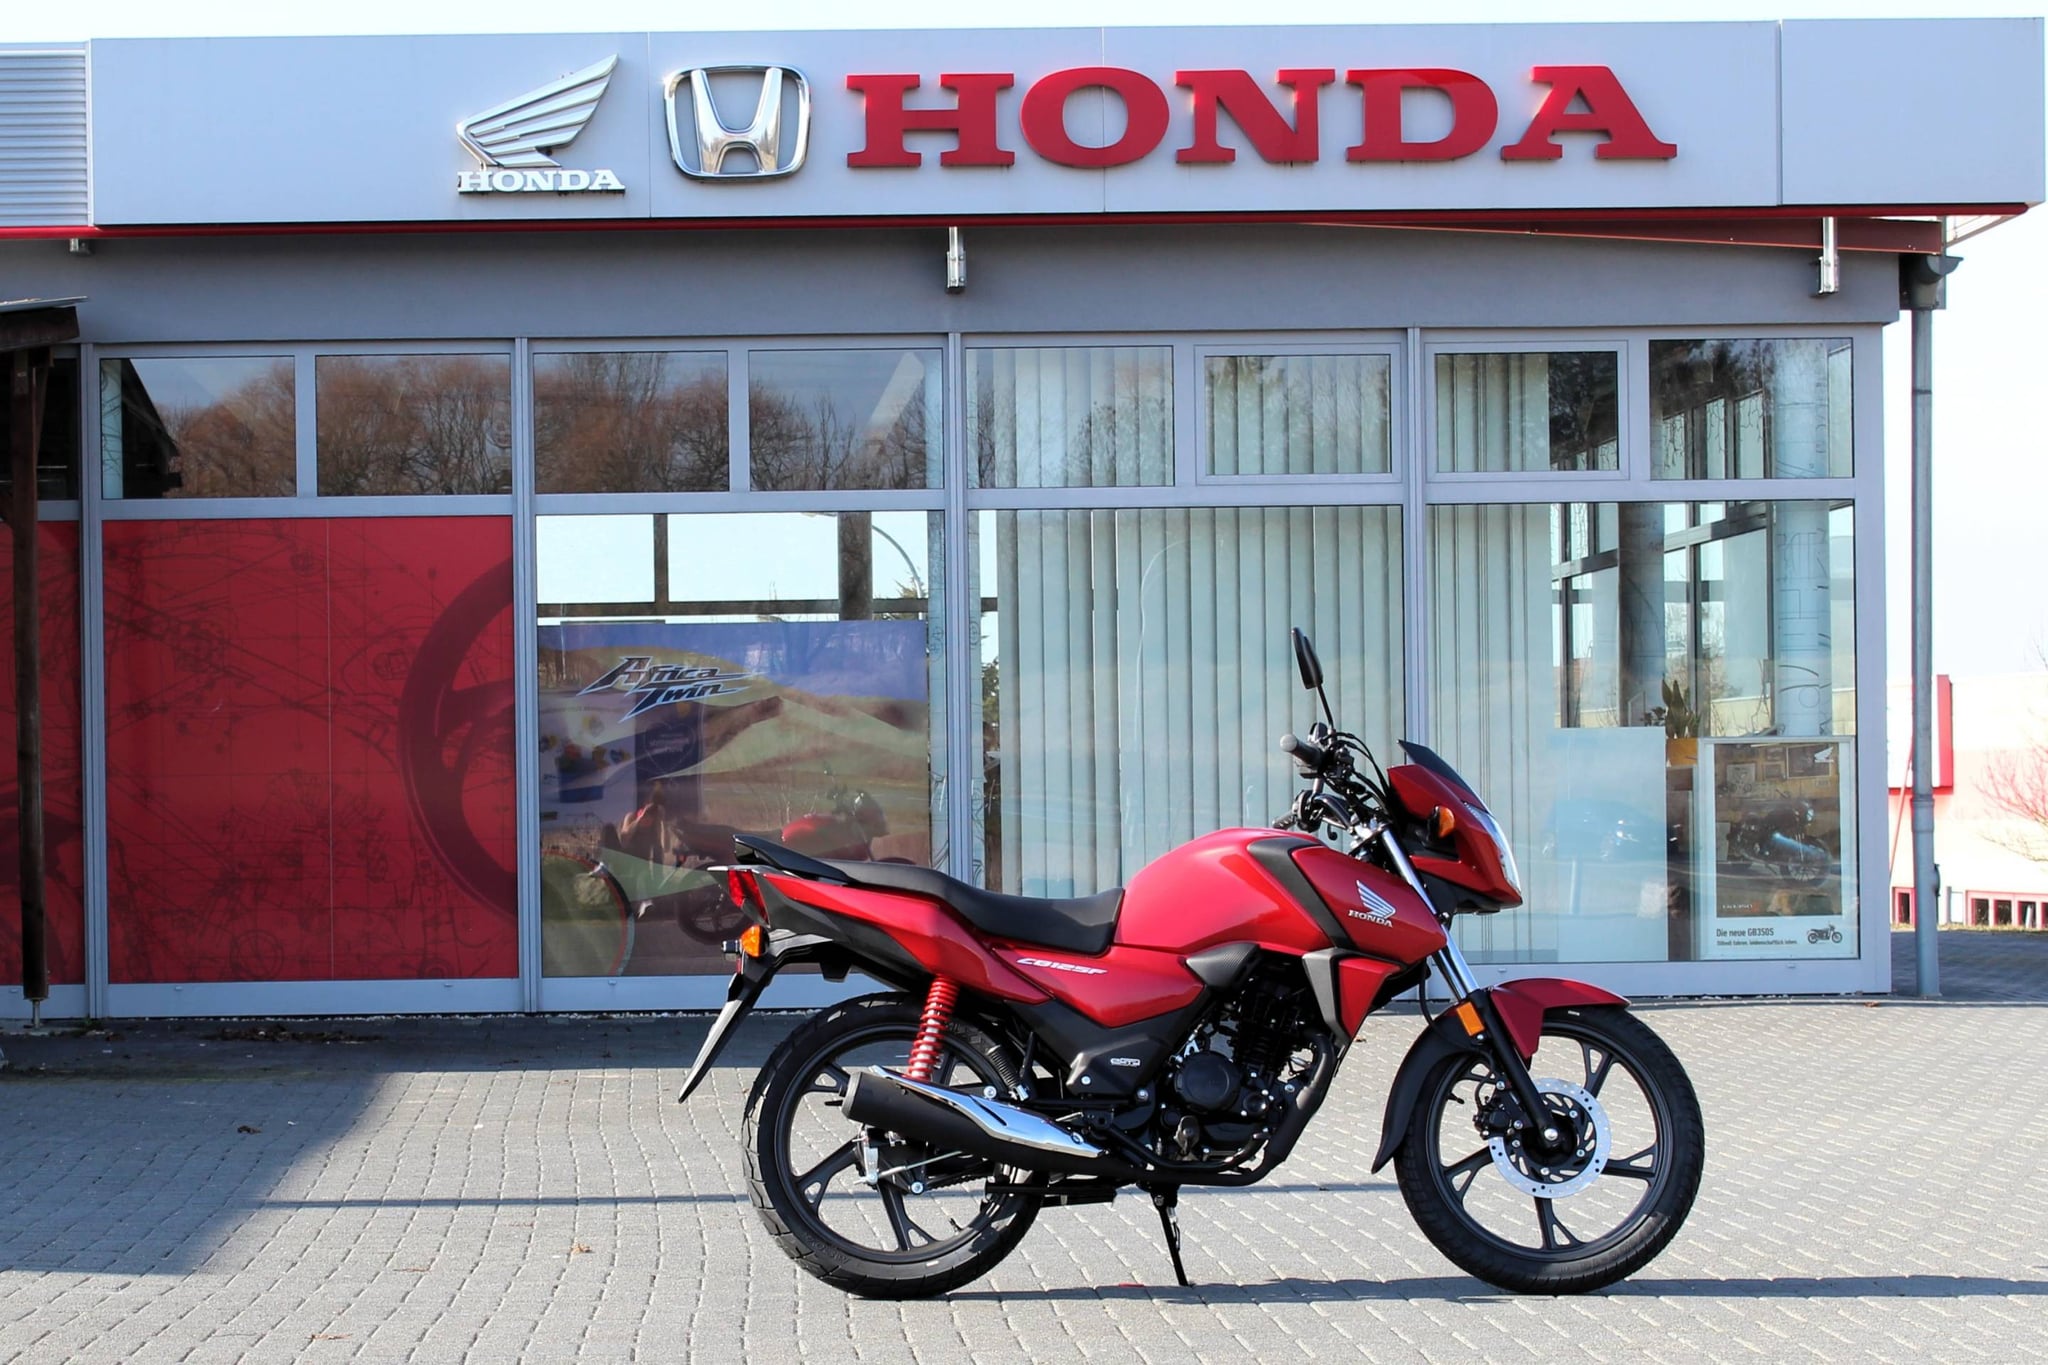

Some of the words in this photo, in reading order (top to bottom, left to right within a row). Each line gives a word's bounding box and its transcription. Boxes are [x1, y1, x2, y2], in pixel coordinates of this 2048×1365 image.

[846, 65, 1678, 169] HONDA
[457, 169, 626, 194] HONDA
[1348, 909, 1393, 928] HONDA
[1716, 928, 1728, 937] Die
[1729, 929, 1746, 937] neue
